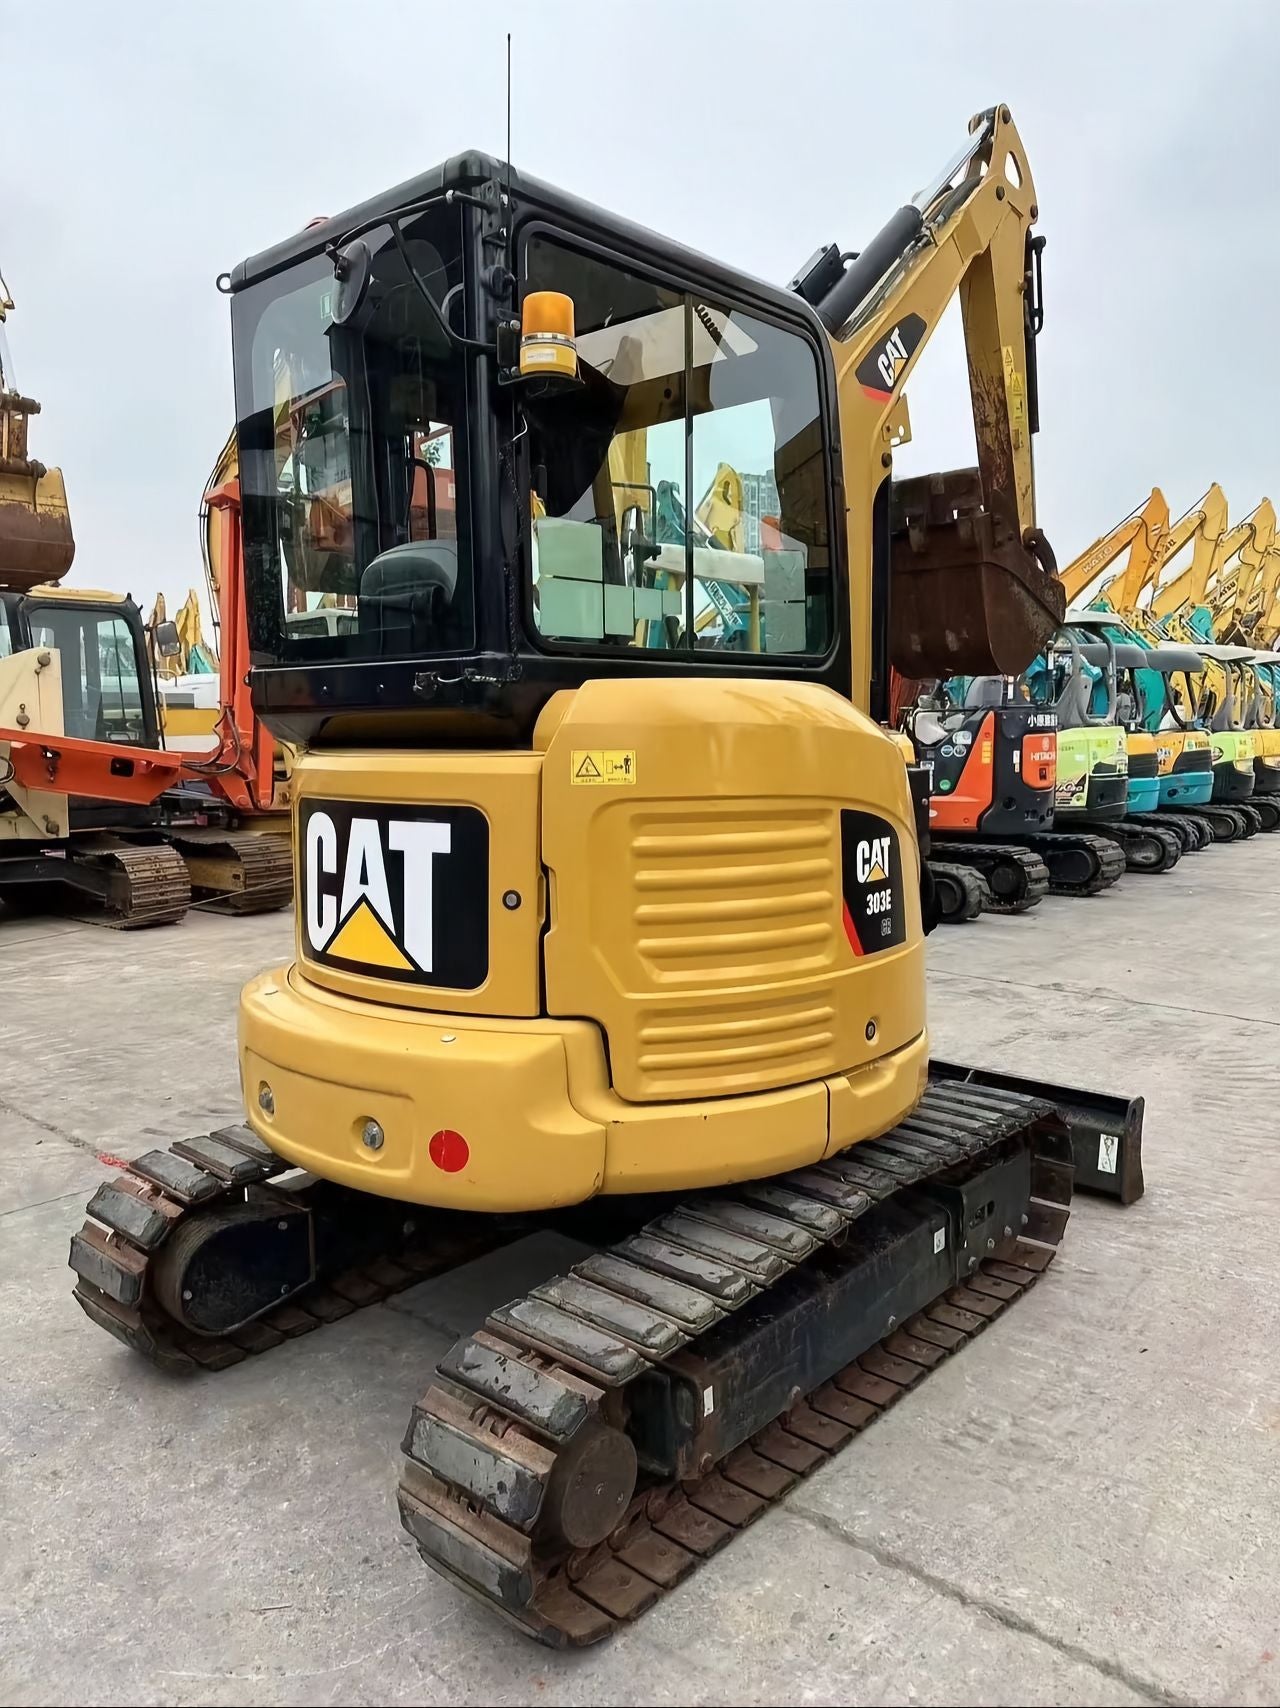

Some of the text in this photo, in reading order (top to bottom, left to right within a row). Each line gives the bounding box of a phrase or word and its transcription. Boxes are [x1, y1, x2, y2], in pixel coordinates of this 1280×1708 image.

[878, 326, 908, 387] CAT
[856, 836, 891, 883] CAT
[306, 811, 451, 973] CAT
[866, 888, 892, 916] 303E
